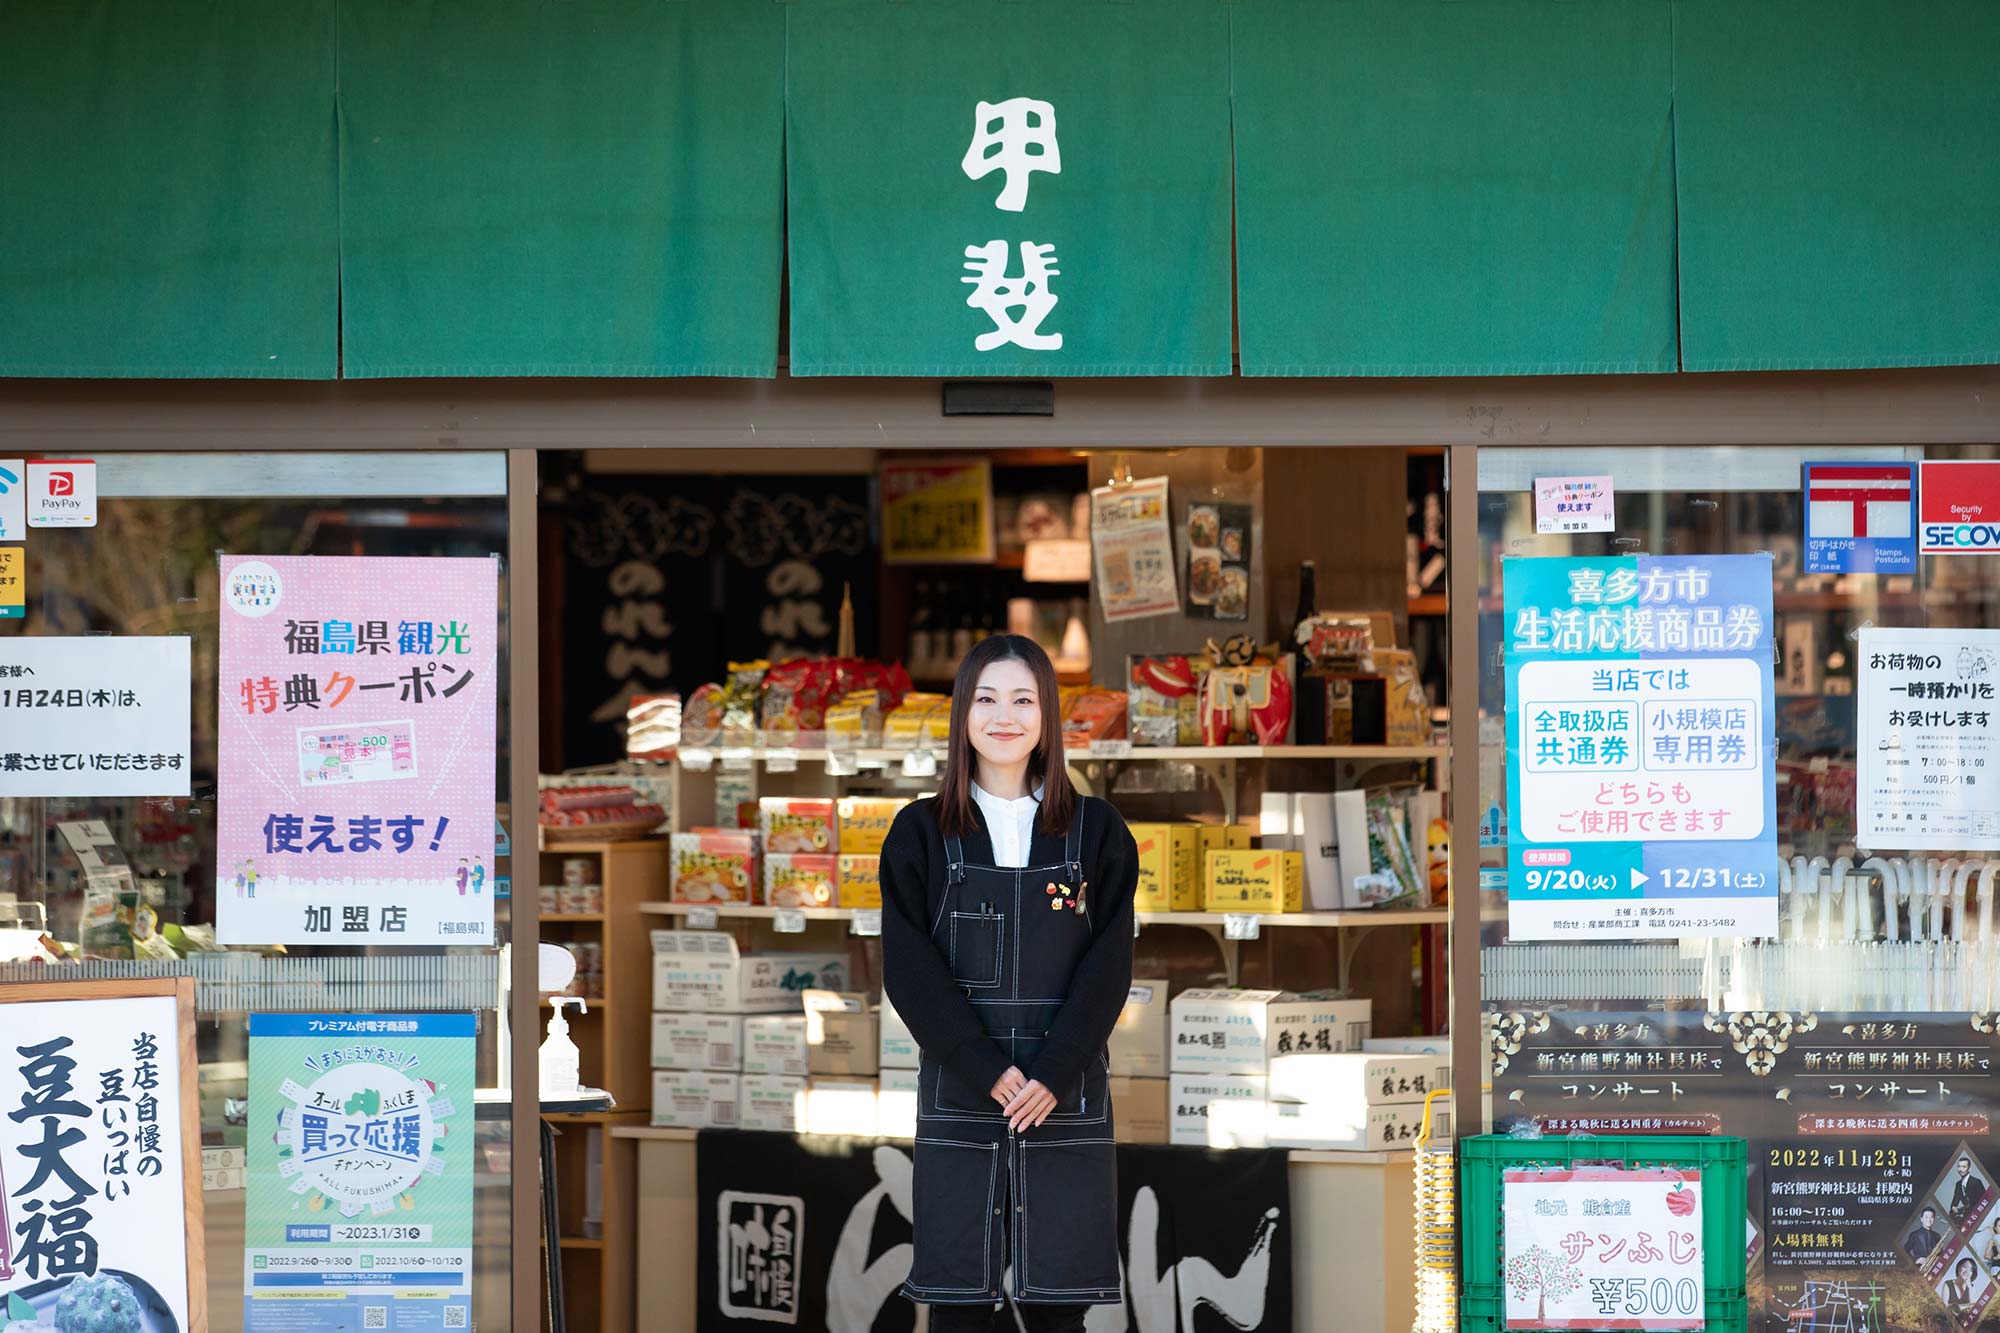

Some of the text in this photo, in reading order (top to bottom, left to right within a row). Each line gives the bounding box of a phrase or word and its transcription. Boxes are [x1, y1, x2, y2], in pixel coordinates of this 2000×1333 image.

[961, 97, 1063, 351] 甲斐
[42, 498, 82, 509] PayPay
[1557, 502, 1592, 512] 使えます
[1950, 504, 1982, 515] Security
[1961, 514, 1972, 522] by
[1875, 548, 1902, 557] Stamps
[1875, 556, 1910, 564] Postcards
[1570, 568, 1709, 602] 喜多方市
[284, 619, 472, 655] 福島県観光
[1515, 607, 1761, 651] 生活応援商品券
[1870, 653, 1942, 671] お荷物の
[241, 661, 475, 715] 特典クーポン
[1592, 668, 1690, 691] 当店では
[1889, 681, 1995, 700] 一時預かりを
[1535, 707, 1746, 732] 全取扱店 小規模店
[1889, 709, 1990, 728] お受けします
[1536, 735, 1747, 765] 共通券 専用券
[0, 753, 184, 771] 業させていただきます
[1595, 782, 1692, 805] どちらも
[1557, 809, 1732, 833] ご使用できます
[1528, 852, 1566, 863] 使用期間
[1525, 867, 1766, 891] 9/20(火) 12/31(土)
[304, 905, 407, 933] 加盟店
[1614, 907, 1675, 917] 主催：喜多方市
[437, 921, 485, 936] 【福島県】
[1648, 919, 1667, 928] 電話
[1668, 918, 1736, 928] 0241-23-5482
[308, 1020, 419, 1032] プレミアム付電子商品券
[1593, 1023, 1650, 1041] 喜多方
[1861, 1023, 1918, 1041] 喜多方
[1536, 1052, 1723, 1071] 新宮熊野神社長床で
[1804, 1052, 1990, 1071] 新宮熊野神社長床で
[313, 1090, 416, 1111] オール ふくしま
[1561, 1081, 1684, 1102] コンサート
[1829, 1081, 1951, 1102] コンサート
[131, 1032, 163, 1177] 当店自慢の
[95, 1068, 131, 1201] 豆いっぱい
[302, 1114, 421, 1158] 買って応援
[7, 1036, 99, 1280] 豆大福
[335, 1158, 392, 1171] キャンペーン
[1770, 1149, 1912, 1167] 2022年11月23日
[323, 1176, 399, 1197] ALL FUKUSHIMA
[1771, 1182, 1913, 1195] 新宮熊野神社長床 拝殿内
[1535, 1199, 1631, 1216] 地元 熊倉産
[290, 1229, 328, 1239] 利用期間
[1772, 1233, 1844, 1247] 入場料無料
[1560, 1231, 1697, 1264] サンふじ
[1590, 1278, 1698, 1315] ¥500
